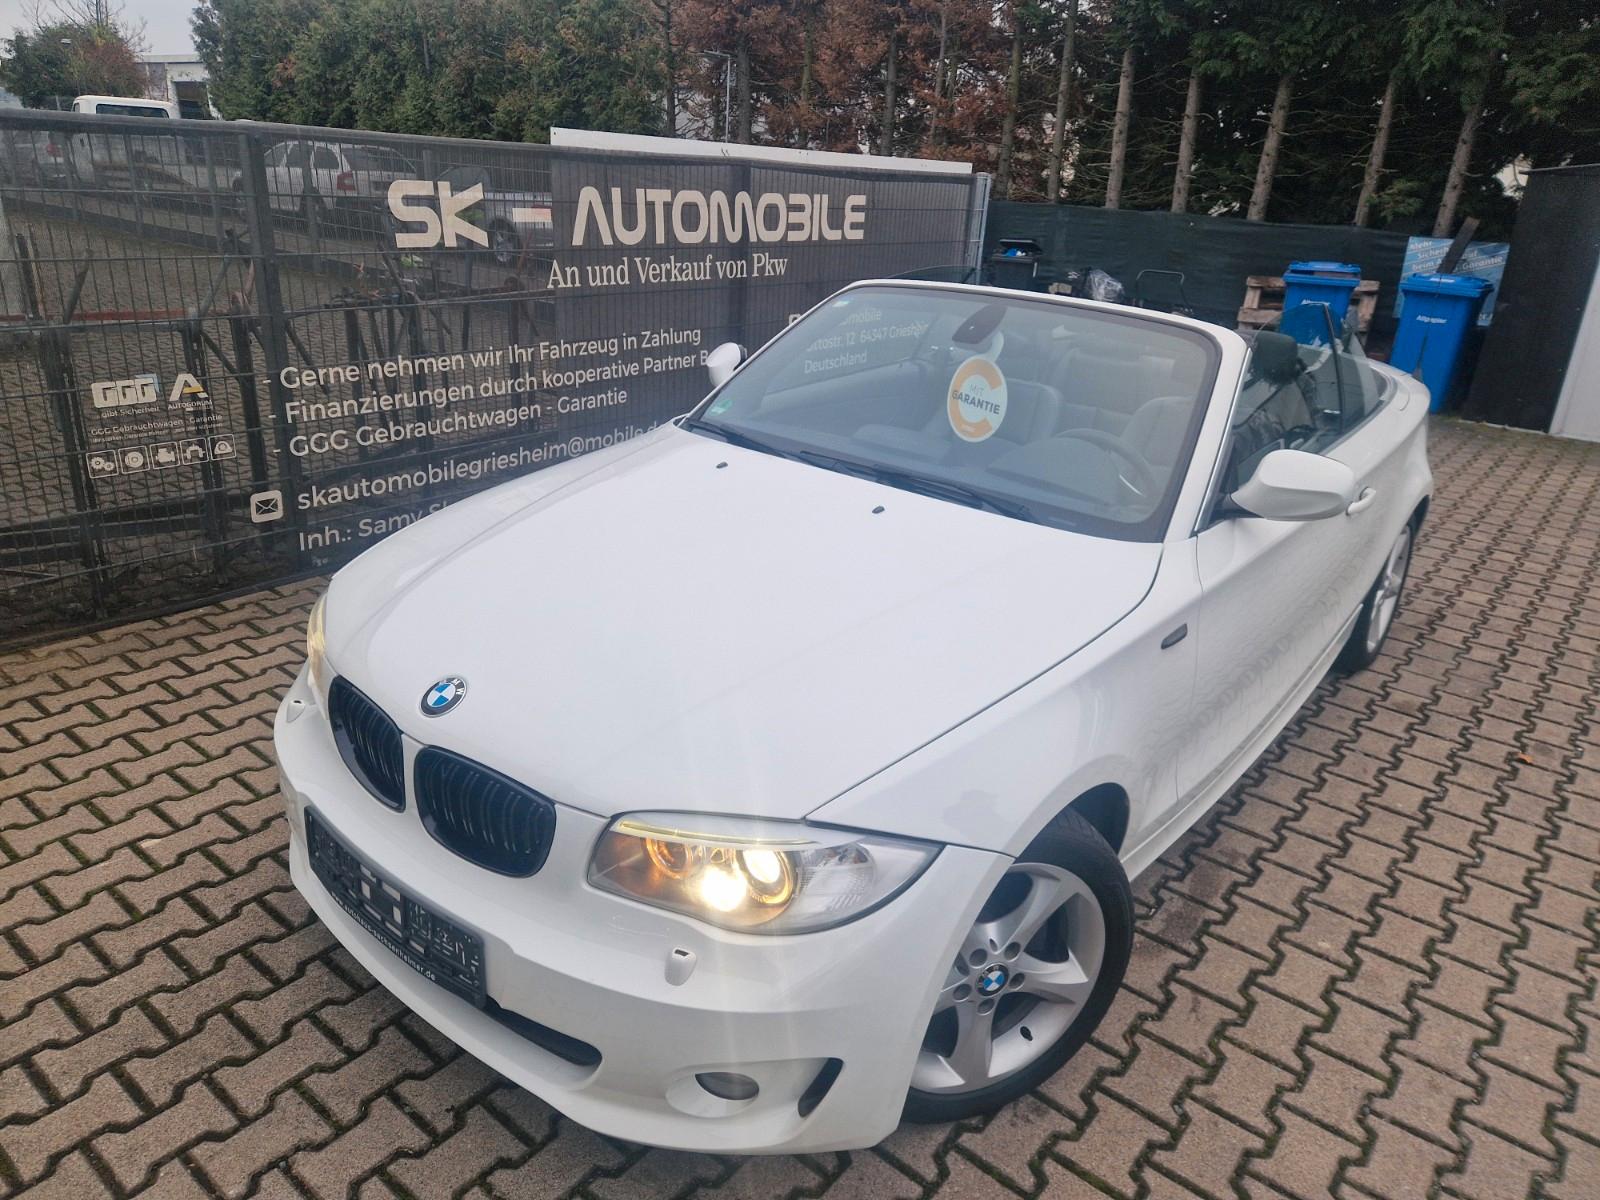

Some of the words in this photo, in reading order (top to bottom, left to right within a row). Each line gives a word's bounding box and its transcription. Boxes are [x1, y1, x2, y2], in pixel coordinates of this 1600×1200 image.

[387, 179, 490, 249] SK
[571, 186, 867, 246] AUTOMOBILE
[547, 259, 581, 289] An
[587, 256, 630, 286] und
[634, 254, 713, 284] Verkauf
[716, 258, 748, 280] von
[752, 252, 788, 277] Pkw
[279, 363, 360, 389] Gerne
[367, 354, 465, 380] nehmen
[470, 346, 503, 368] wir
[508, 344, 535, 364] Ihr
[539, 338, 618, 361] Fahrzeug
[622, 332, 637, 350] in
[641, 328, 701, 349] Zahlung
[804, 348, 868, 374] Deutschland
[285, 381, 474, 424] Finanzierungen
[479, 369, 538, 398] durch
[542, 360, 640, 389] kooperative
[643, 352, 697, 374] Partner
[951, 389, 1001, 415] GARANTIE
[112, 419, 184, 434] Gebrauchtwagen
[189, 414, 223, 424] Garantie
[289, 429, 349, 457] GGG
[355, 404, 541, 447] Gebrauchtwagen
[556, 387, 628, 414] Garantie
[299, 525, 352, 552] Inh.:
